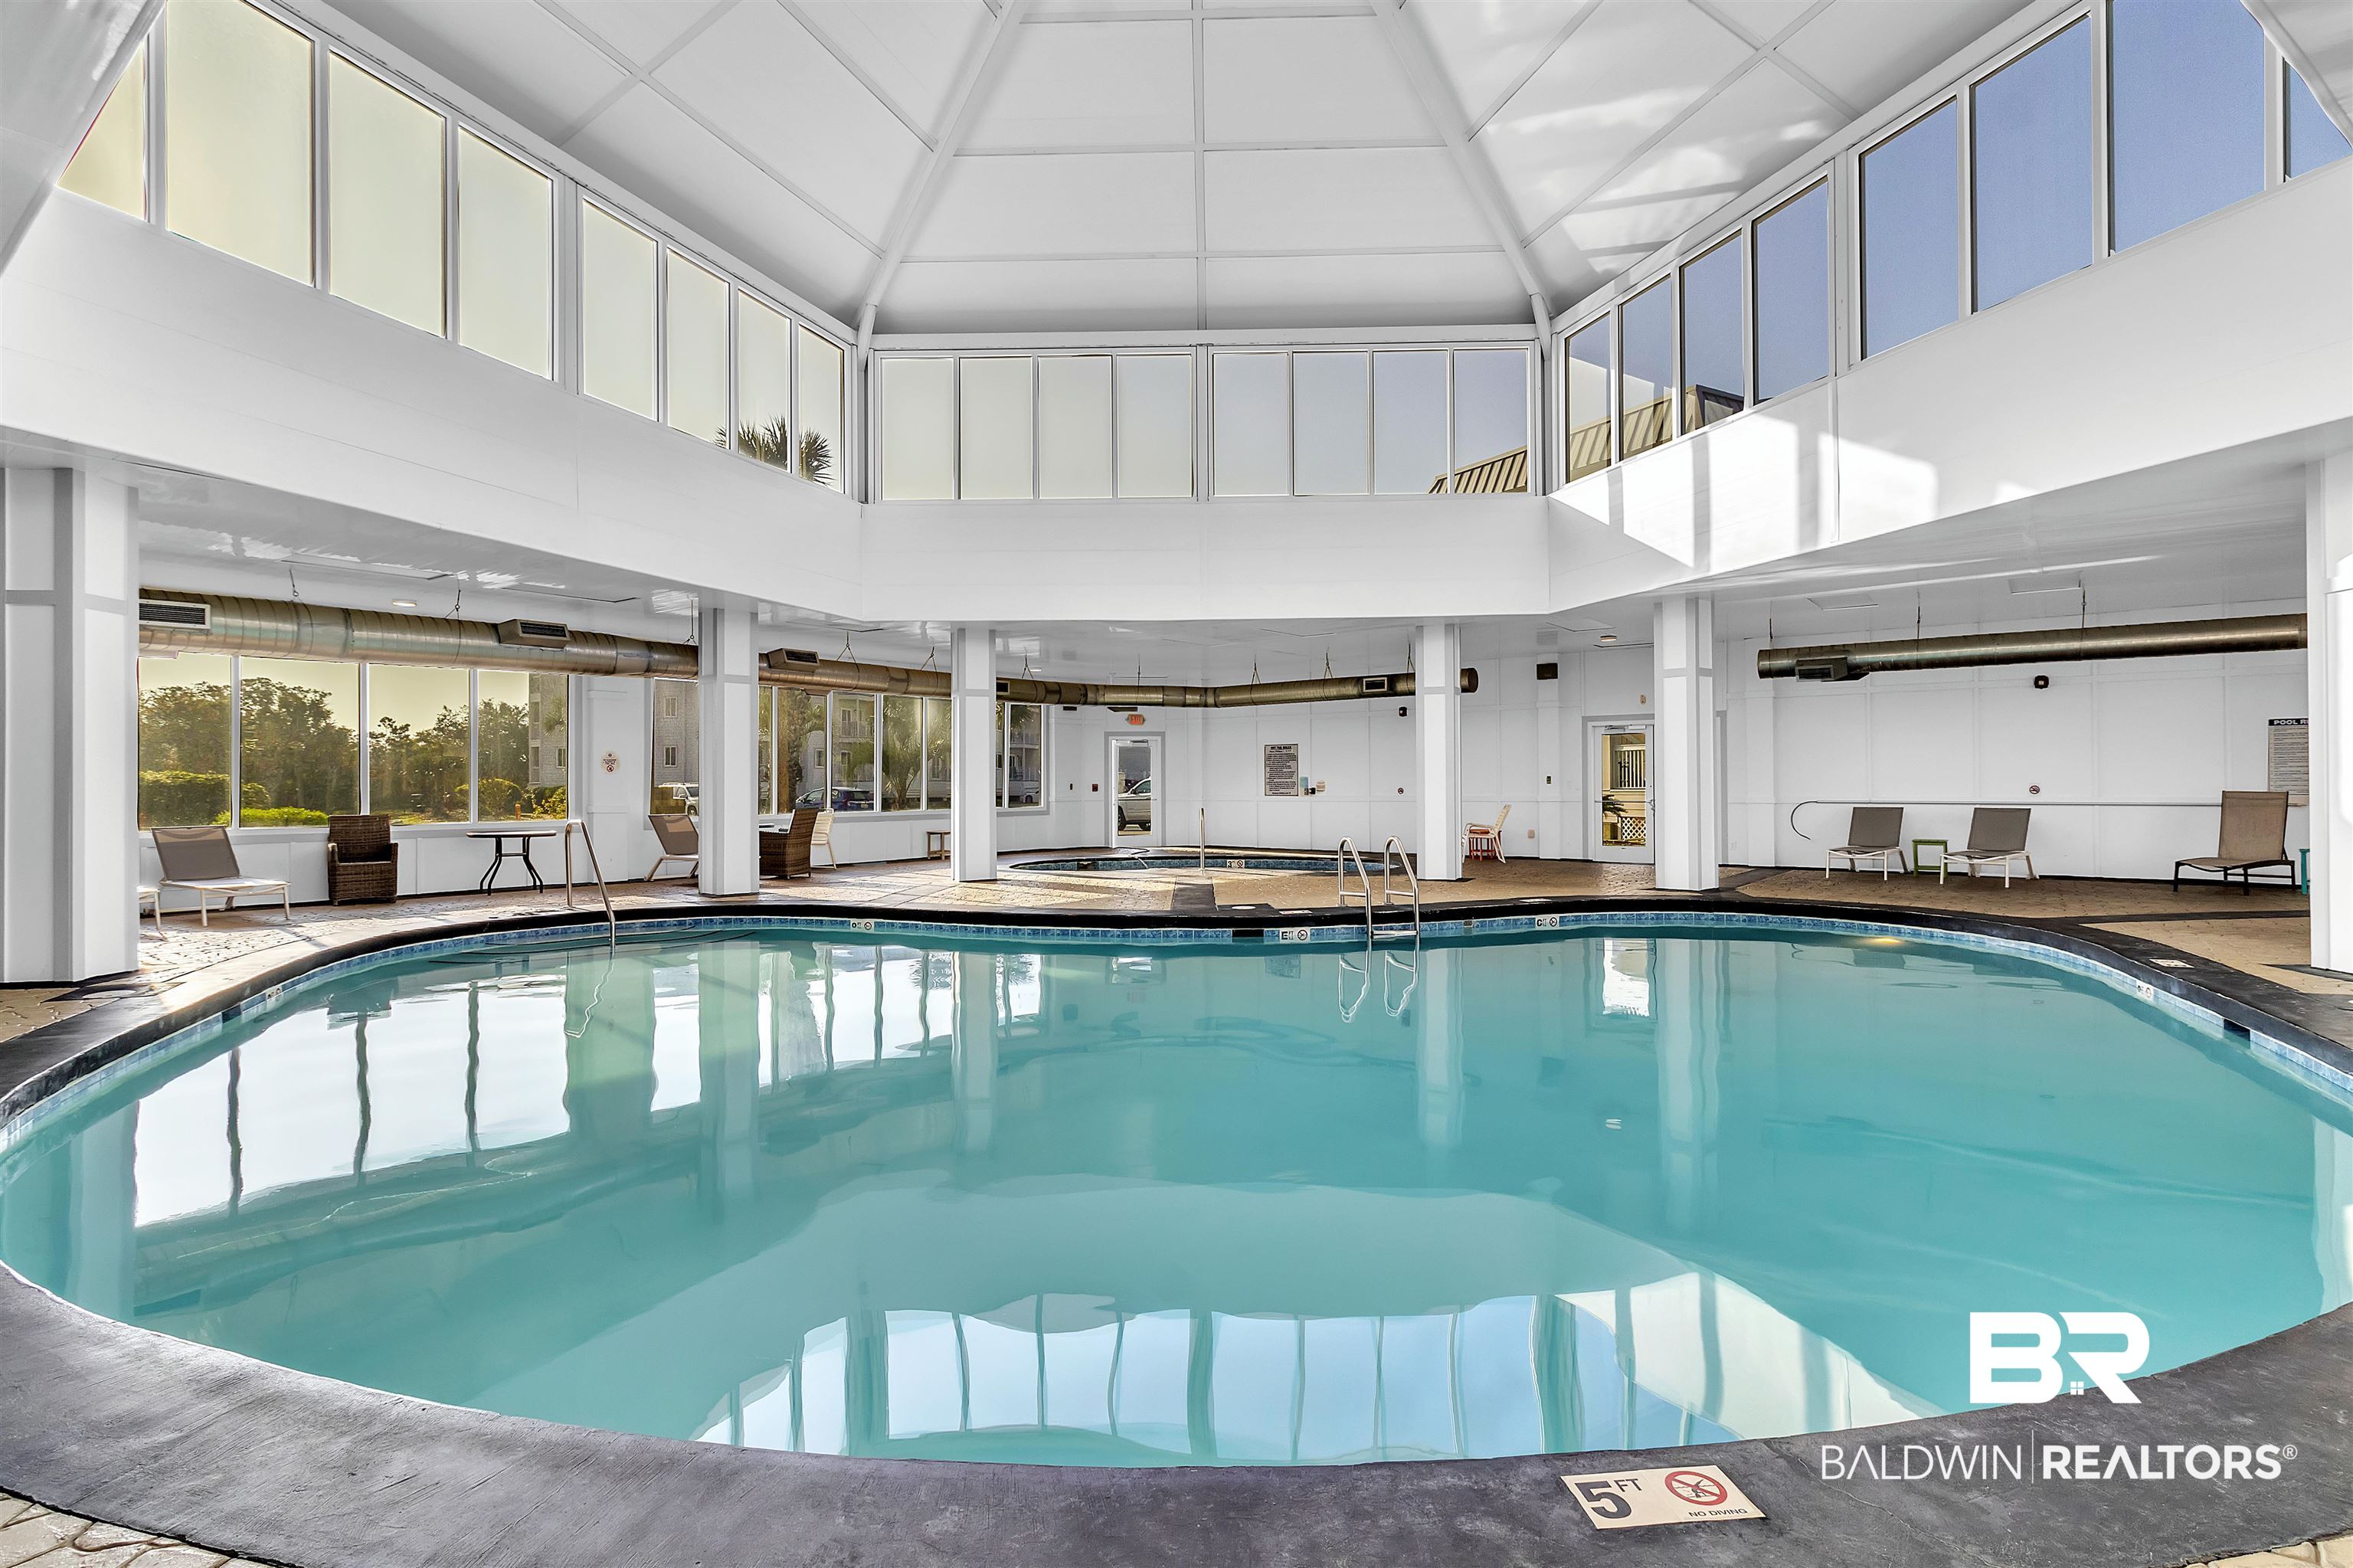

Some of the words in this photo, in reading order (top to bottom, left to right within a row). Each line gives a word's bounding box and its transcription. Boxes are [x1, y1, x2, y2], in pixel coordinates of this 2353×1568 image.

[1574, 1480, 1632, 1520] 5
[1614, 1478, 1642, 1493] FT
[1688, 1509, 1707, 1517] NO
[1708, 1507, 1749, 1517] DIVING
